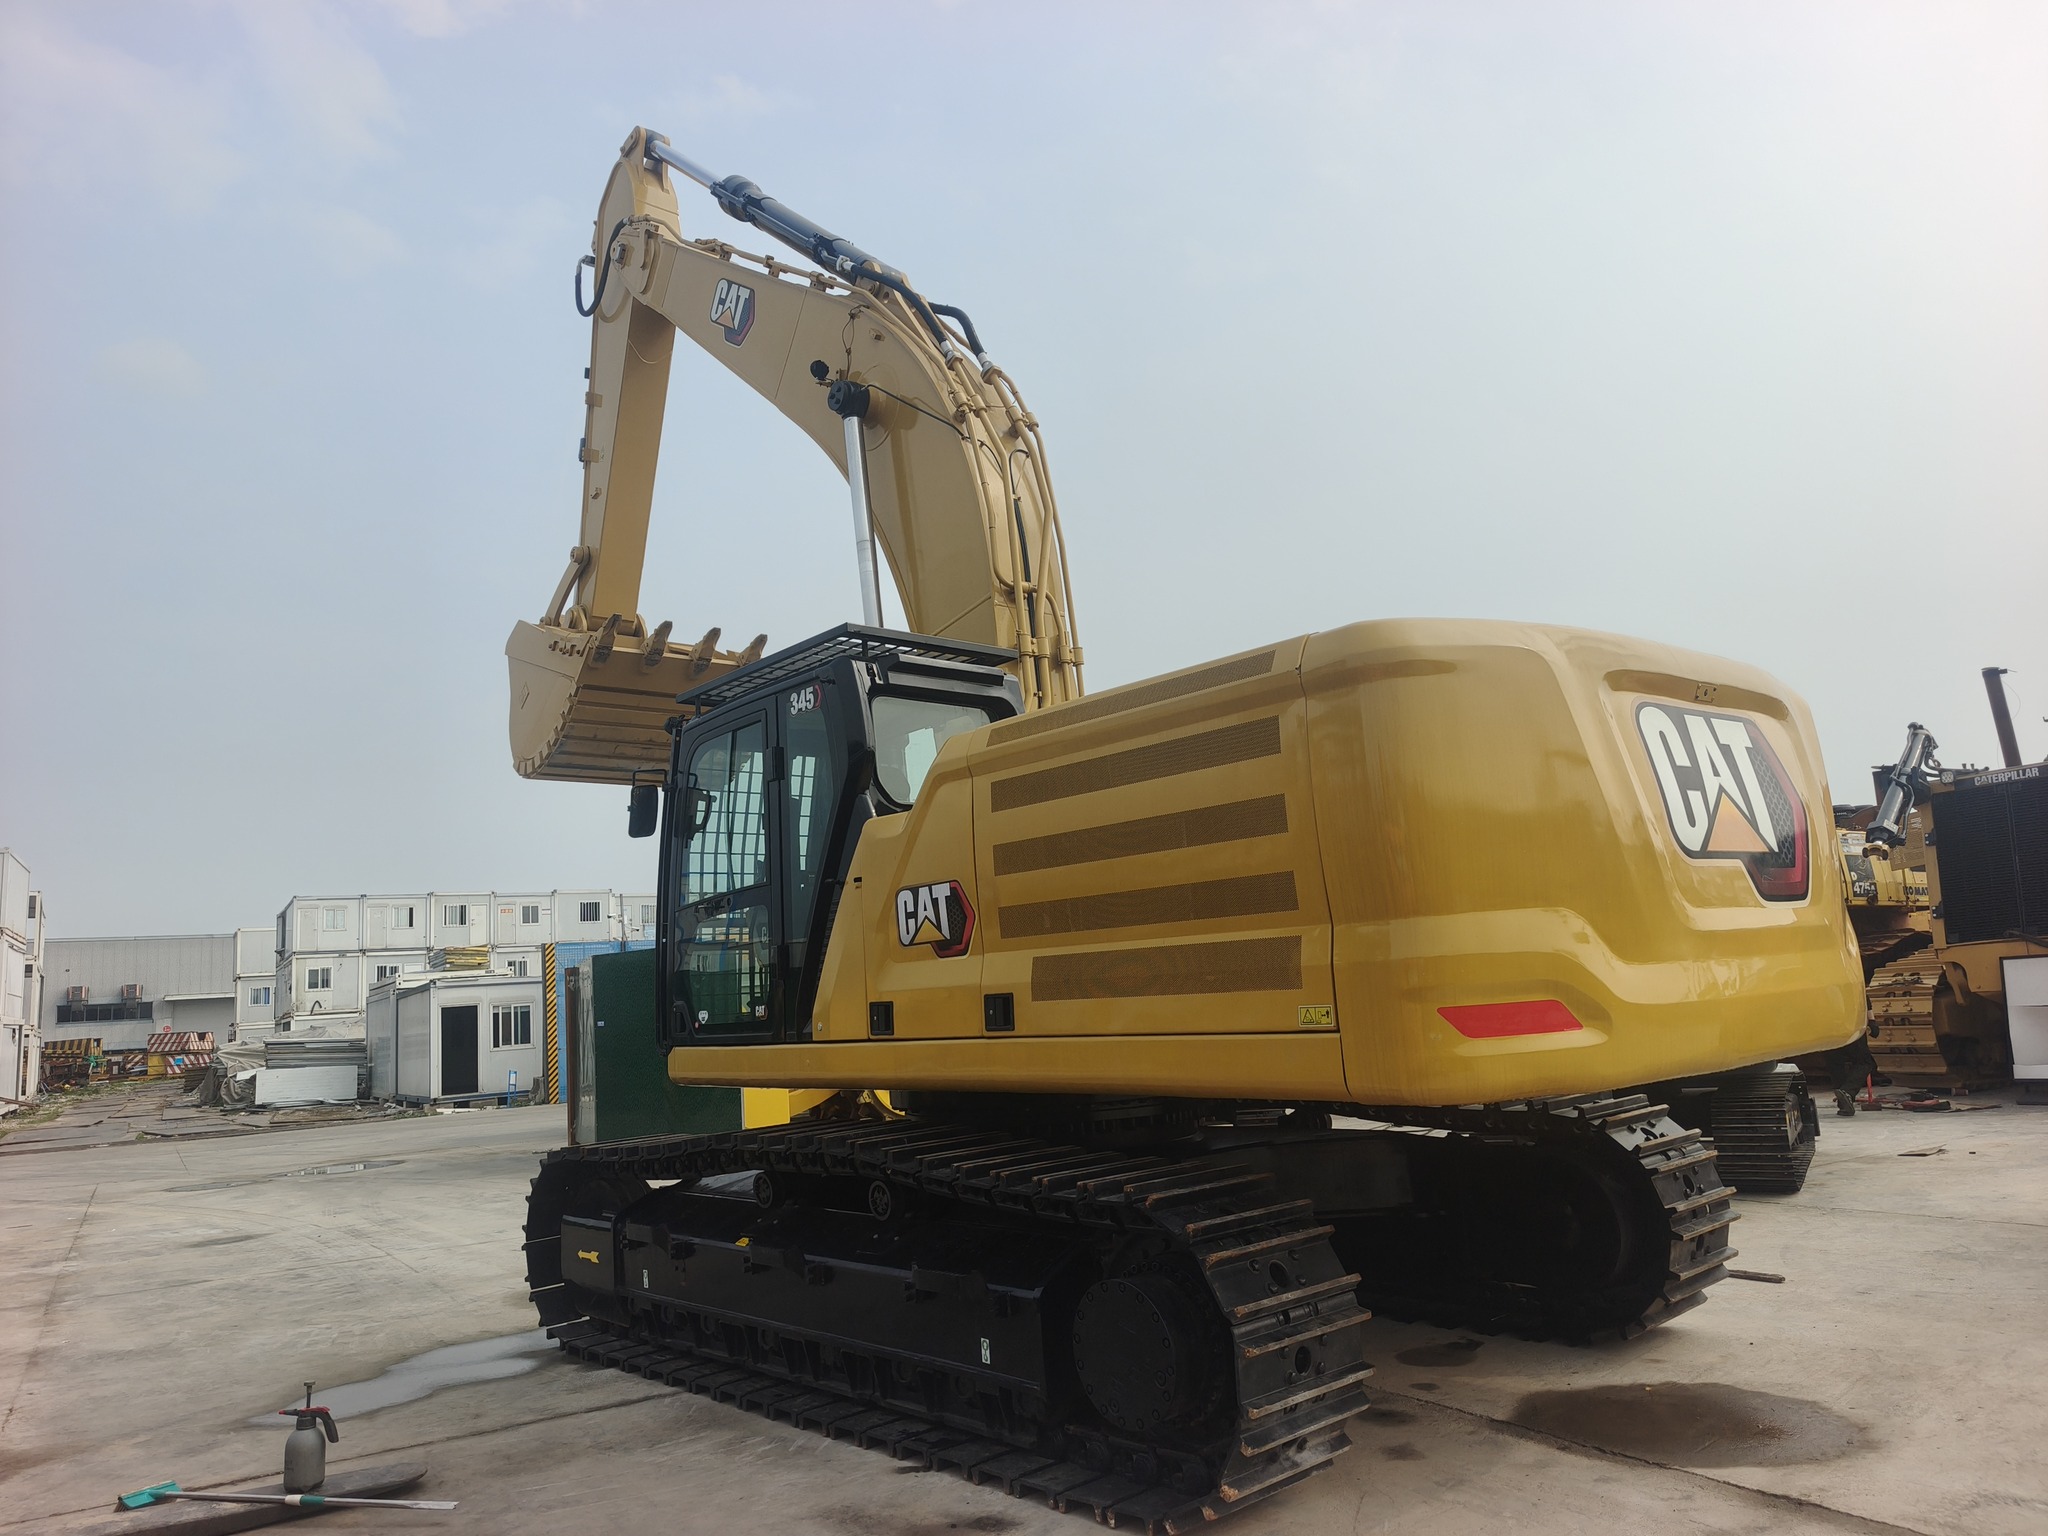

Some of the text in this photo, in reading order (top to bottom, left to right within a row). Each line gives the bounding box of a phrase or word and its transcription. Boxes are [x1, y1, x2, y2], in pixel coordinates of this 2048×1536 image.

[711, 279, 751, 330] CAT
[790, 686, 815, 715] 345
[1639, 706, 1779, 853] CAT
[1974, 767, 2040, 786] CATERPILLAR
[897, 882, 951, 946] CAT
[755, 1005, 765, 1017] CAT
